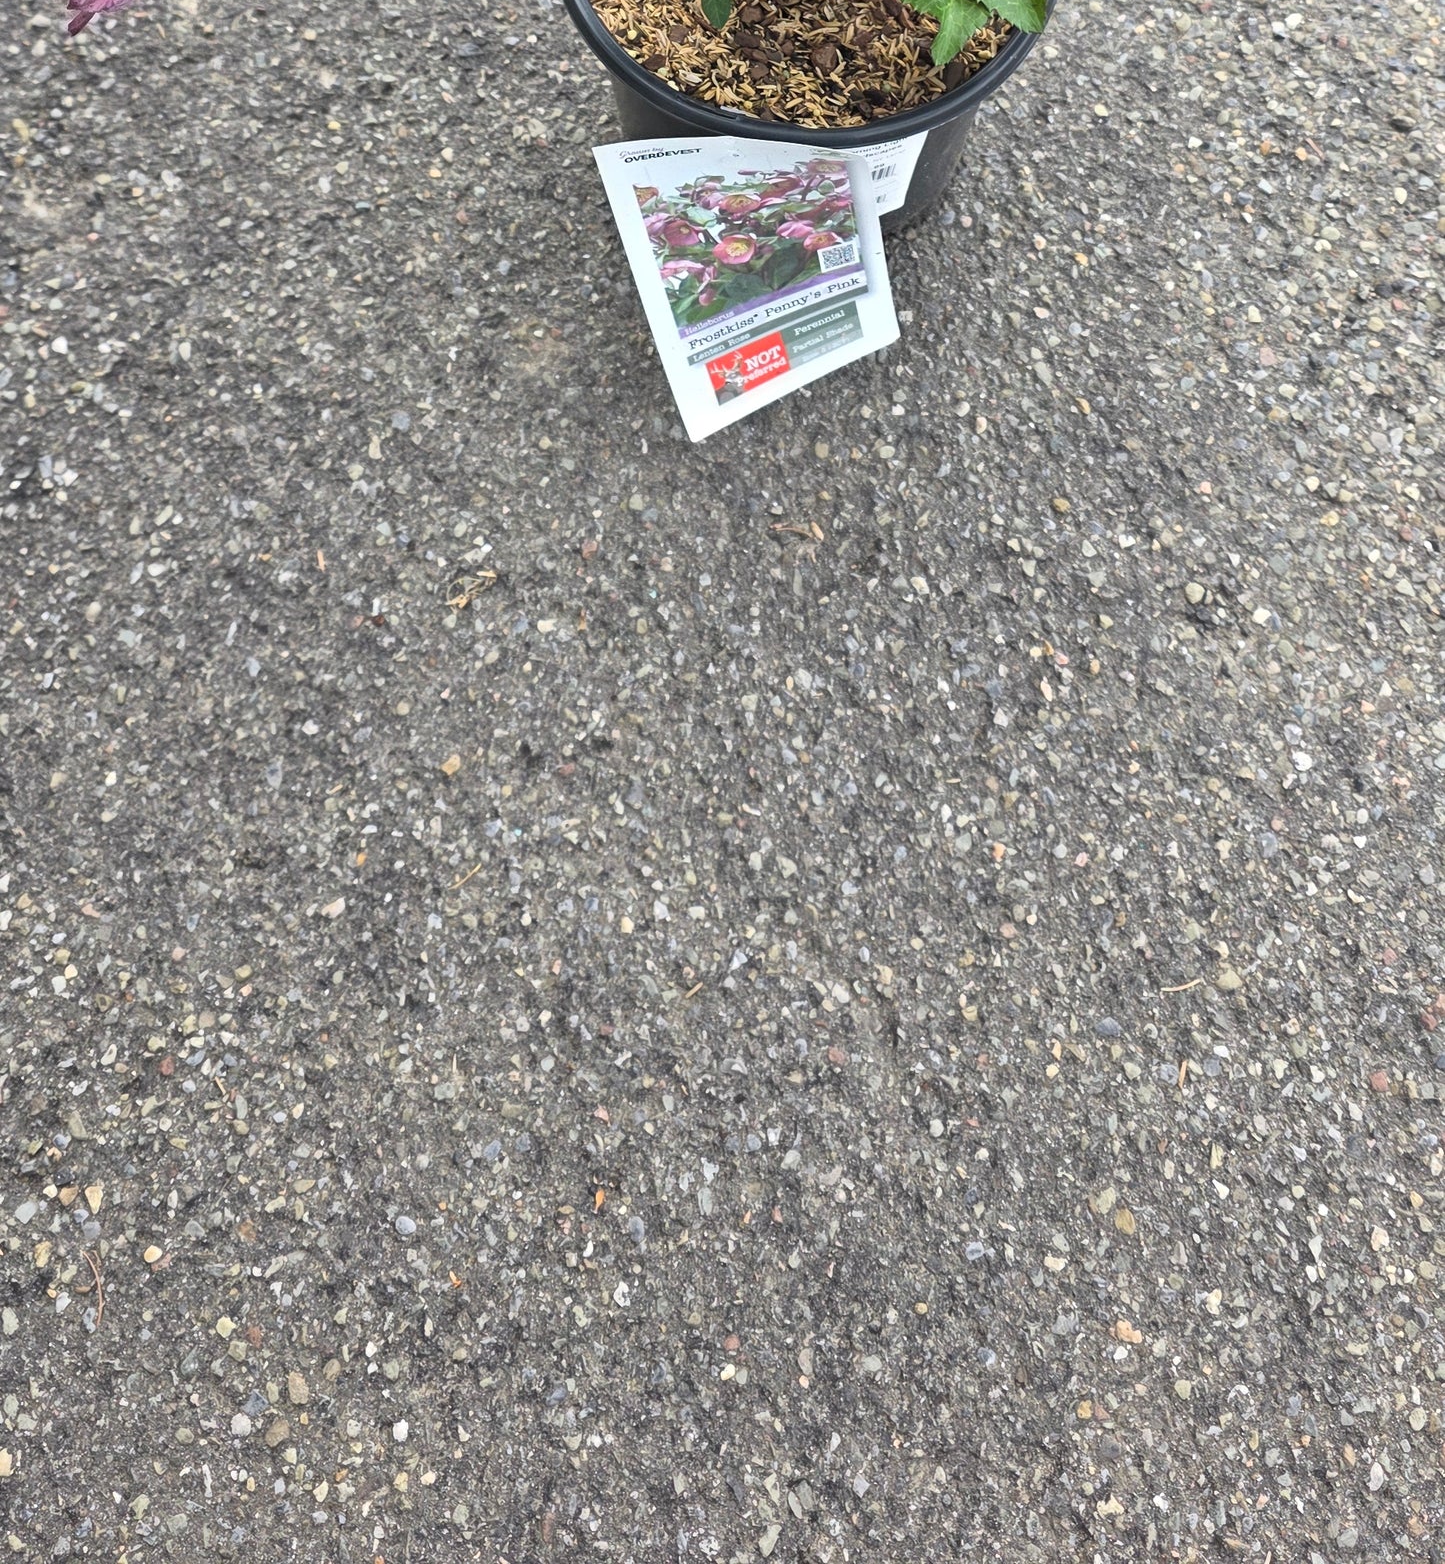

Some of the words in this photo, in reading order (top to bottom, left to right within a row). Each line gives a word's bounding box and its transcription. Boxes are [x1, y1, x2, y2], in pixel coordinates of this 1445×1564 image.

[624, 148, 702, 163] OVERDEVEST
[764, 291, 821, 318] Penny's
[827, 277, 860, 294] Pink
[793, 309, 845, 336] Perennial
[736, 356, 787, 387] Preferred
[744, 345, 782, 371] NOT
